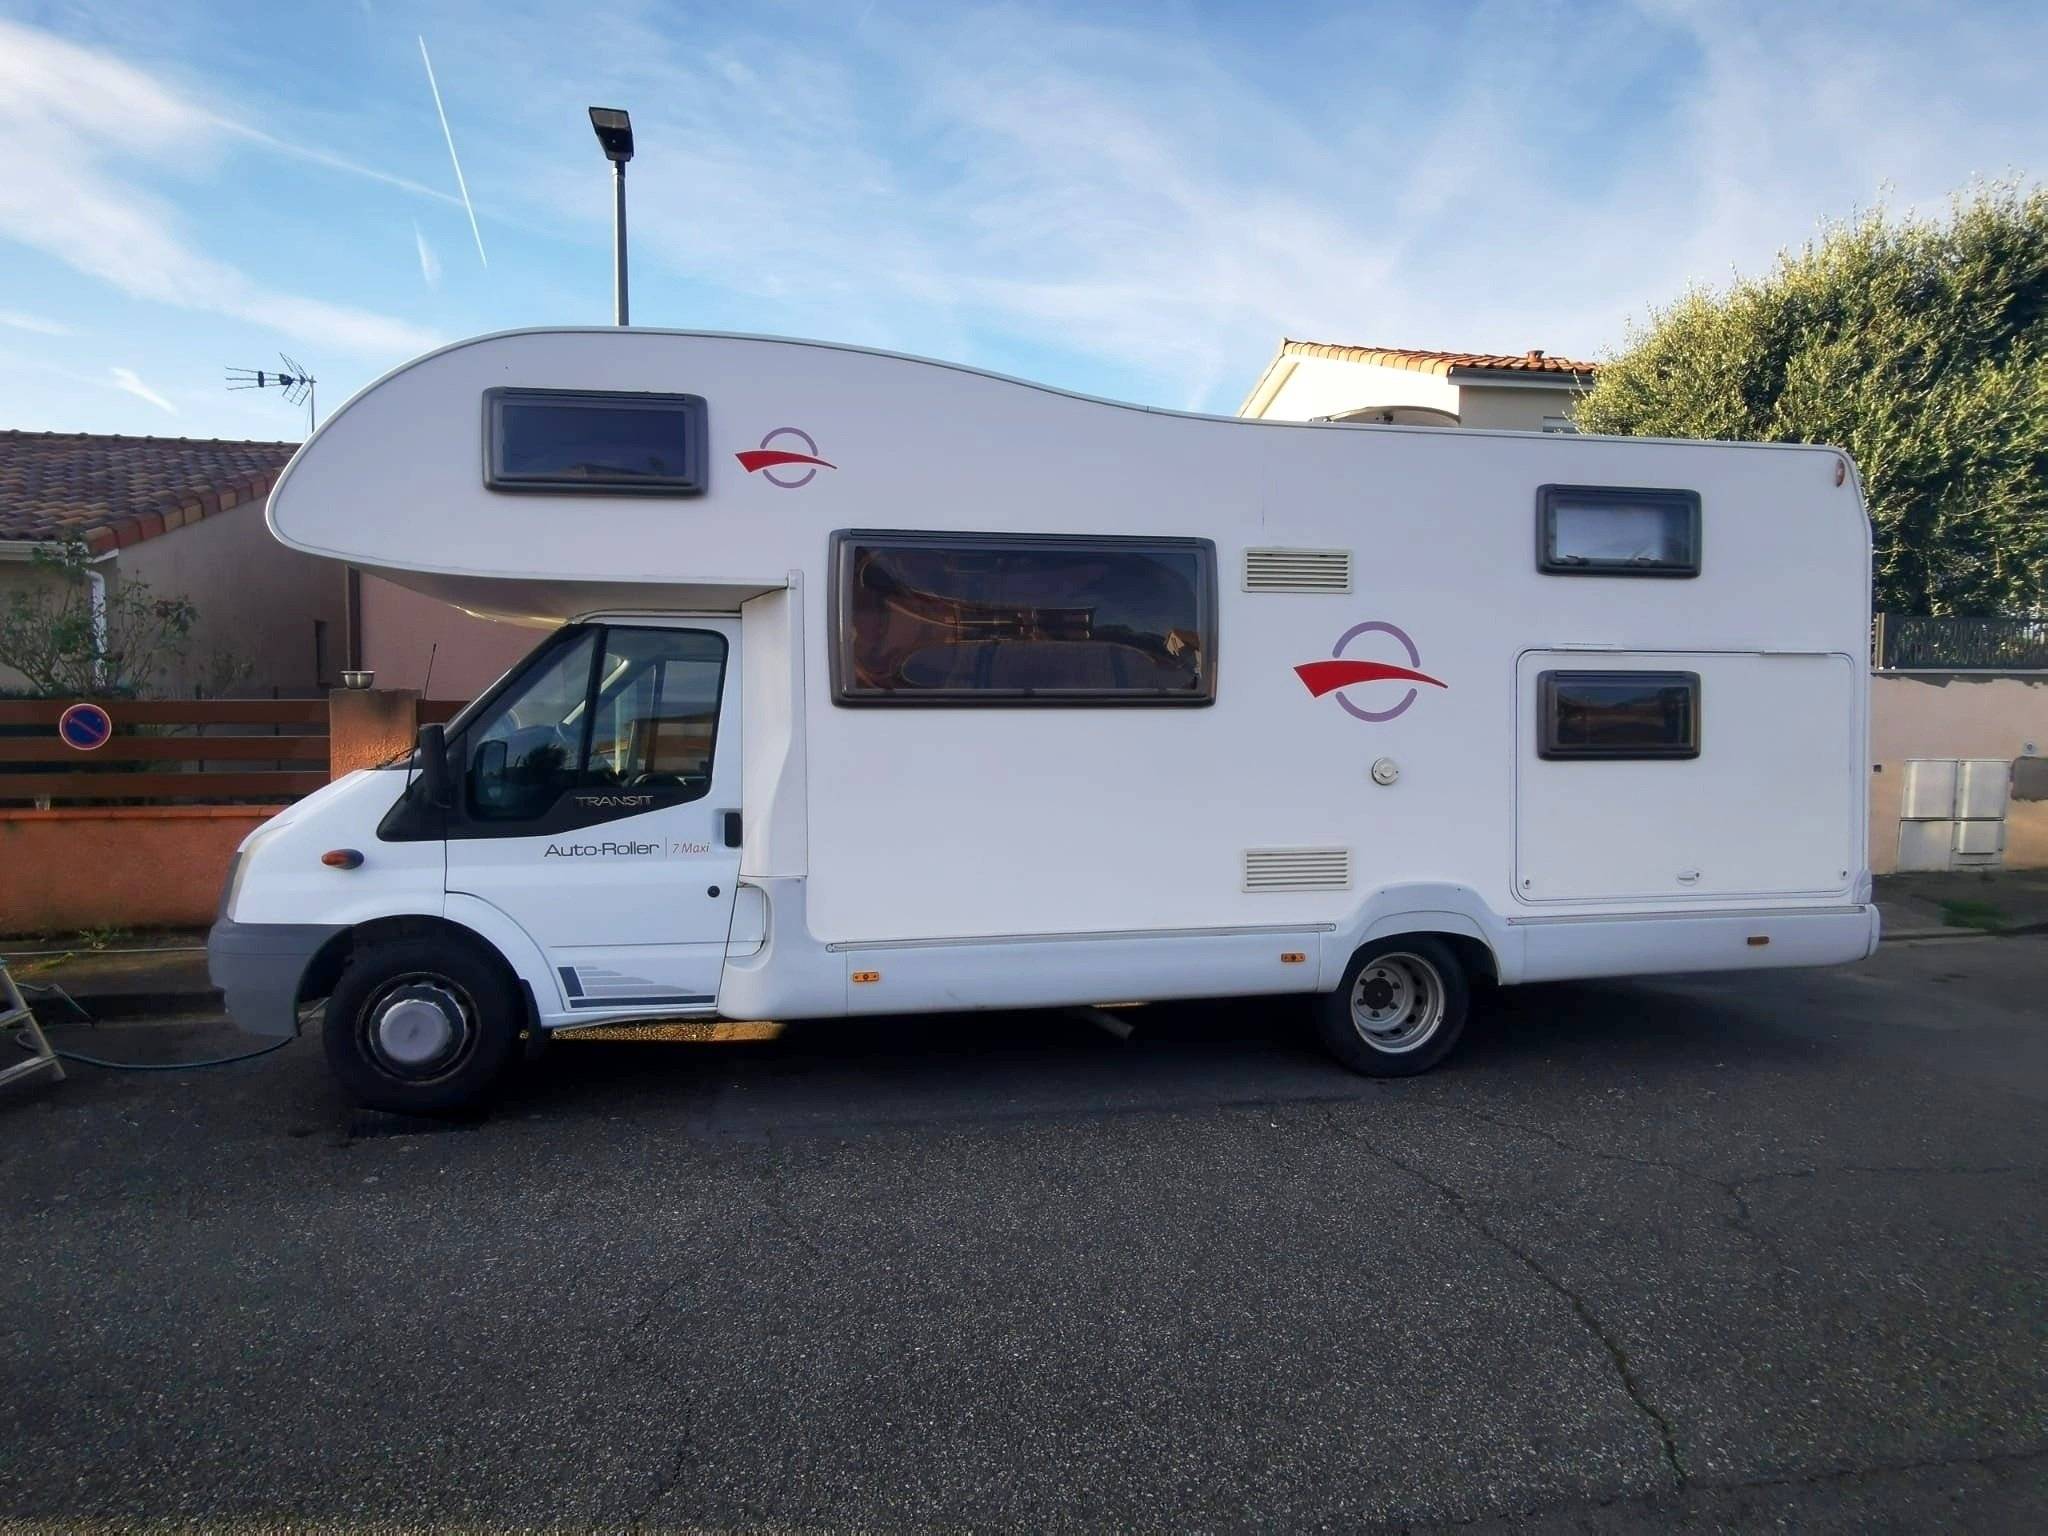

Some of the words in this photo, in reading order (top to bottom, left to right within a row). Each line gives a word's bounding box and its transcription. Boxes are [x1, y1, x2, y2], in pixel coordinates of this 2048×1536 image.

[575, 795, 654, 808] TRANSIT
[544, 841, 660, 858] Auto-Roller
[672, 843, 680, 854] 7
[681, 842, 711, 854] Maxi
